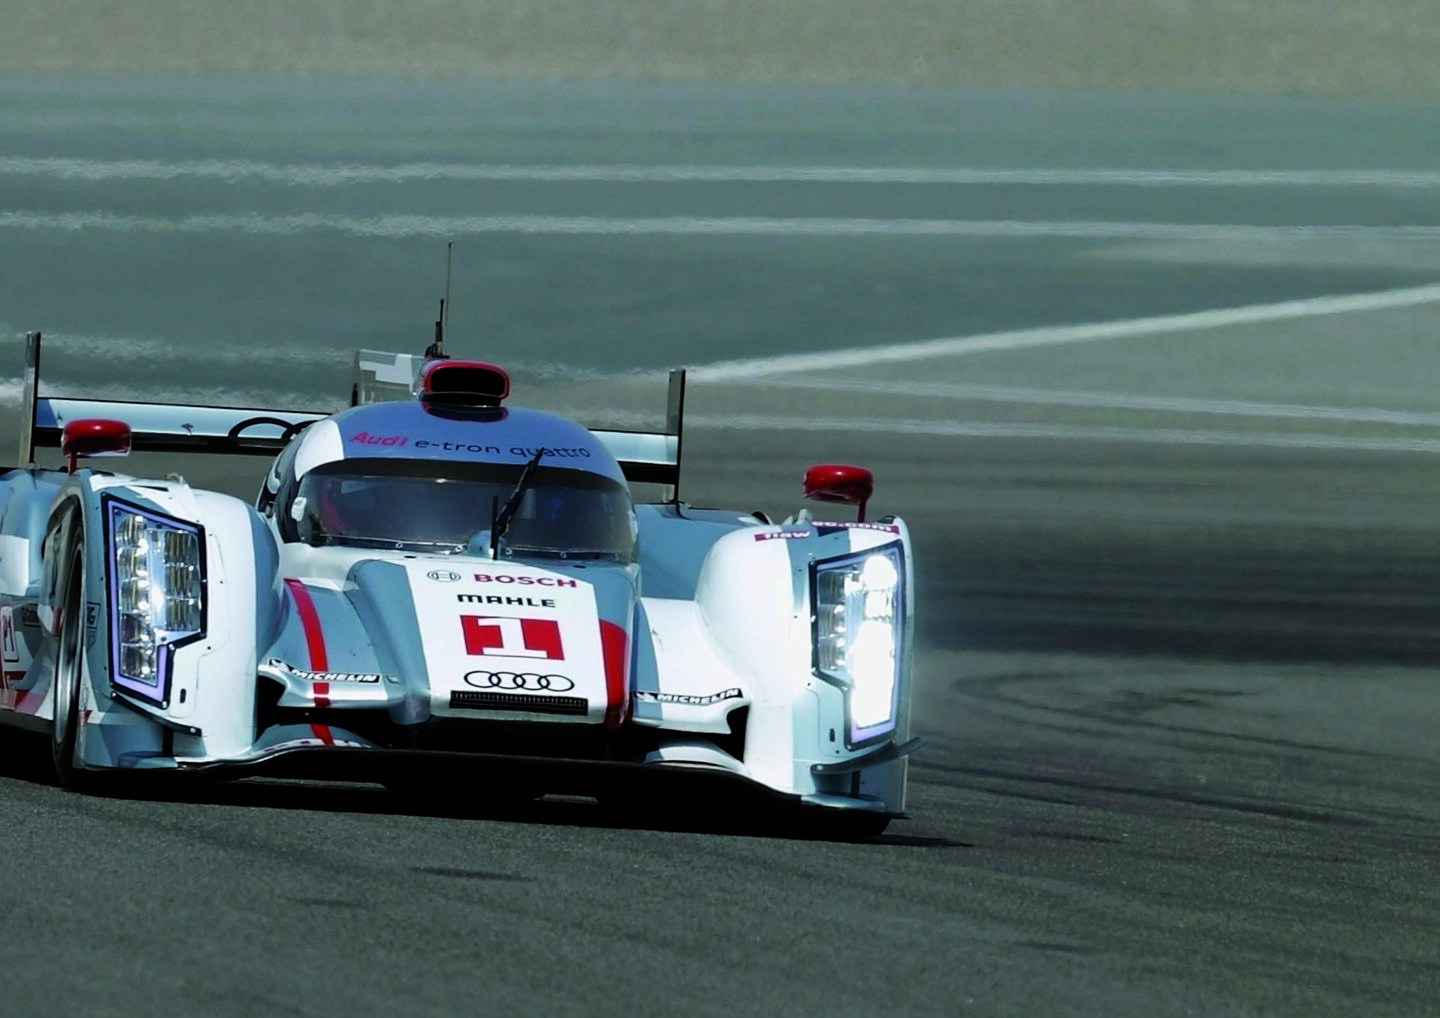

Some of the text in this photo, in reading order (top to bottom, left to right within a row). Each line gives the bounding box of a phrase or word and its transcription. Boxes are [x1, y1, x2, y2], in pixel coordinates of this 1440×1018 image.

[350, 432, 591, 458] Audi e-tron quattro
[474, 574, 577, 588] BOSCH
[457, 594, 556, 608] MAHLE
[476, 616, 549, 659] 1
[291, 668, 377, 682] MICHELIN
[656, 689, 739, 705] MICHELIN
